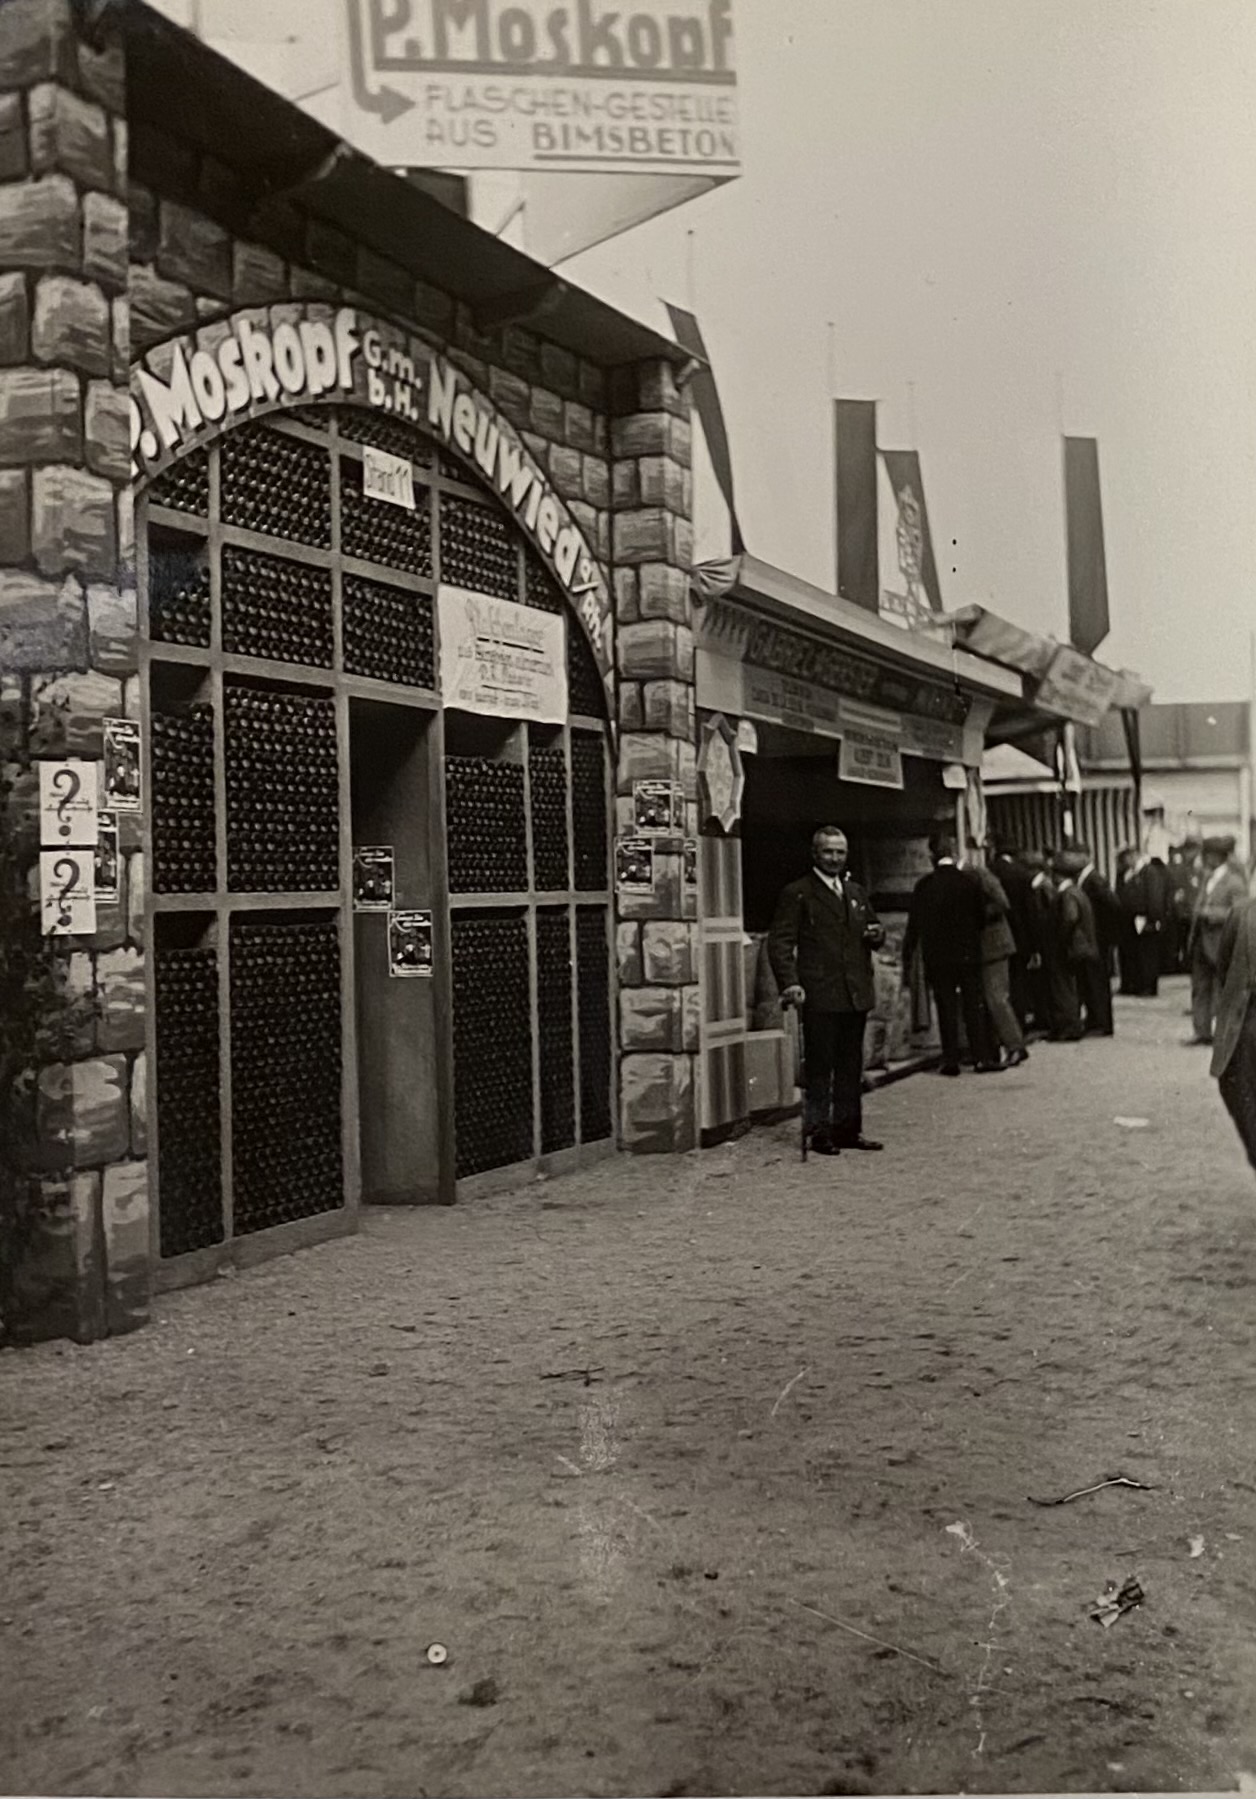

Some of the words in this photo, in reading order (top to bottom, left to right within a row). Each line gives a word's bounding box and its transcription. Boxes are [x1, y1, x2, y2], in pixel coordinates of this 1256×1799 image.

[425, 84, 734, 125] FLASCHEN-GESTELLE
[425, 118, 498, 148] AUS
[531, 122, 737, 157] BIMSBETON
[428, 355, 582, 587] Neuwied
